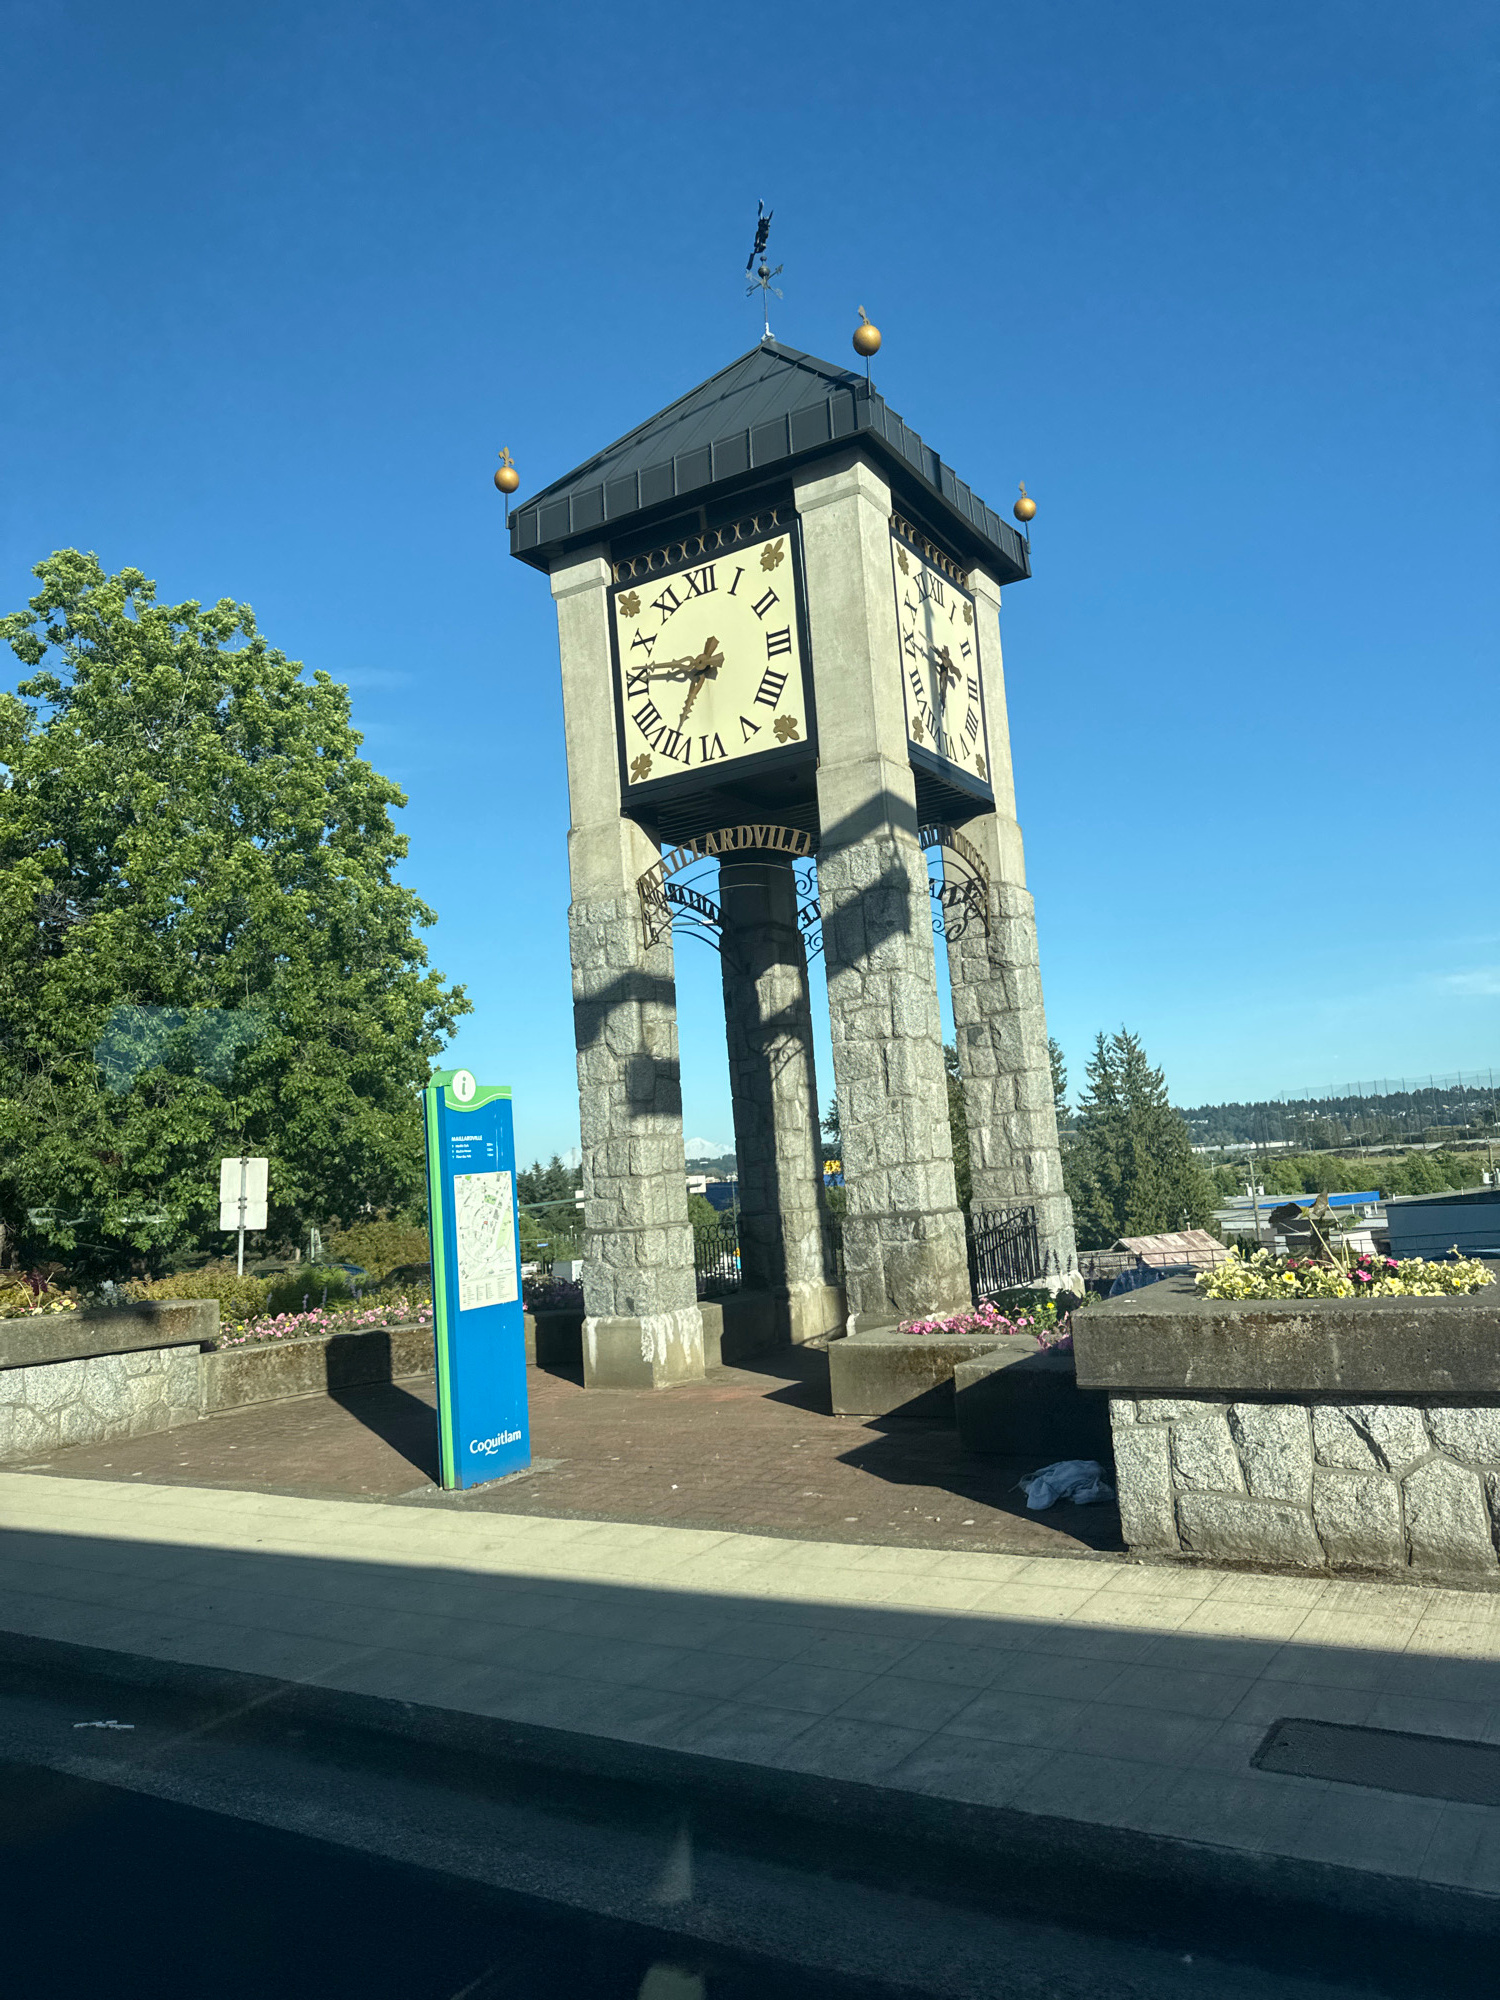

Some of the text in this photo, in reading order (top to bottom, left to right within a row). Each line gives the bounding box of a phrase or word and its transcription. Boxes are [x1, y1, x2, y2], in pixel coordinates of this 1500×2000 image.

[682, 563, 719, 602] XII
[727, 567, 745, 596] I
[927, 571, 945, 608] XII
[650, 584, 684, 626] XI
[751, 587, 780, 620] II
[904, 588, 917, 626] X
[949, 600, 957, 625] I
[630, 628, 658, 658] X
[766, 624, 792, 661] III
[959, 637, 972, 661] II
[626, 663, 650, 701] IX
[753, 666, 789, 711] IIII
[967, 673, 980, 705] III
[631, 698, 667, 752] VIII
[739, 715, 762, 743] V
[965, 703, 979, 745] IIII
[659, 728, 691, 765] VII
[698, 732, 729, 763] VI
